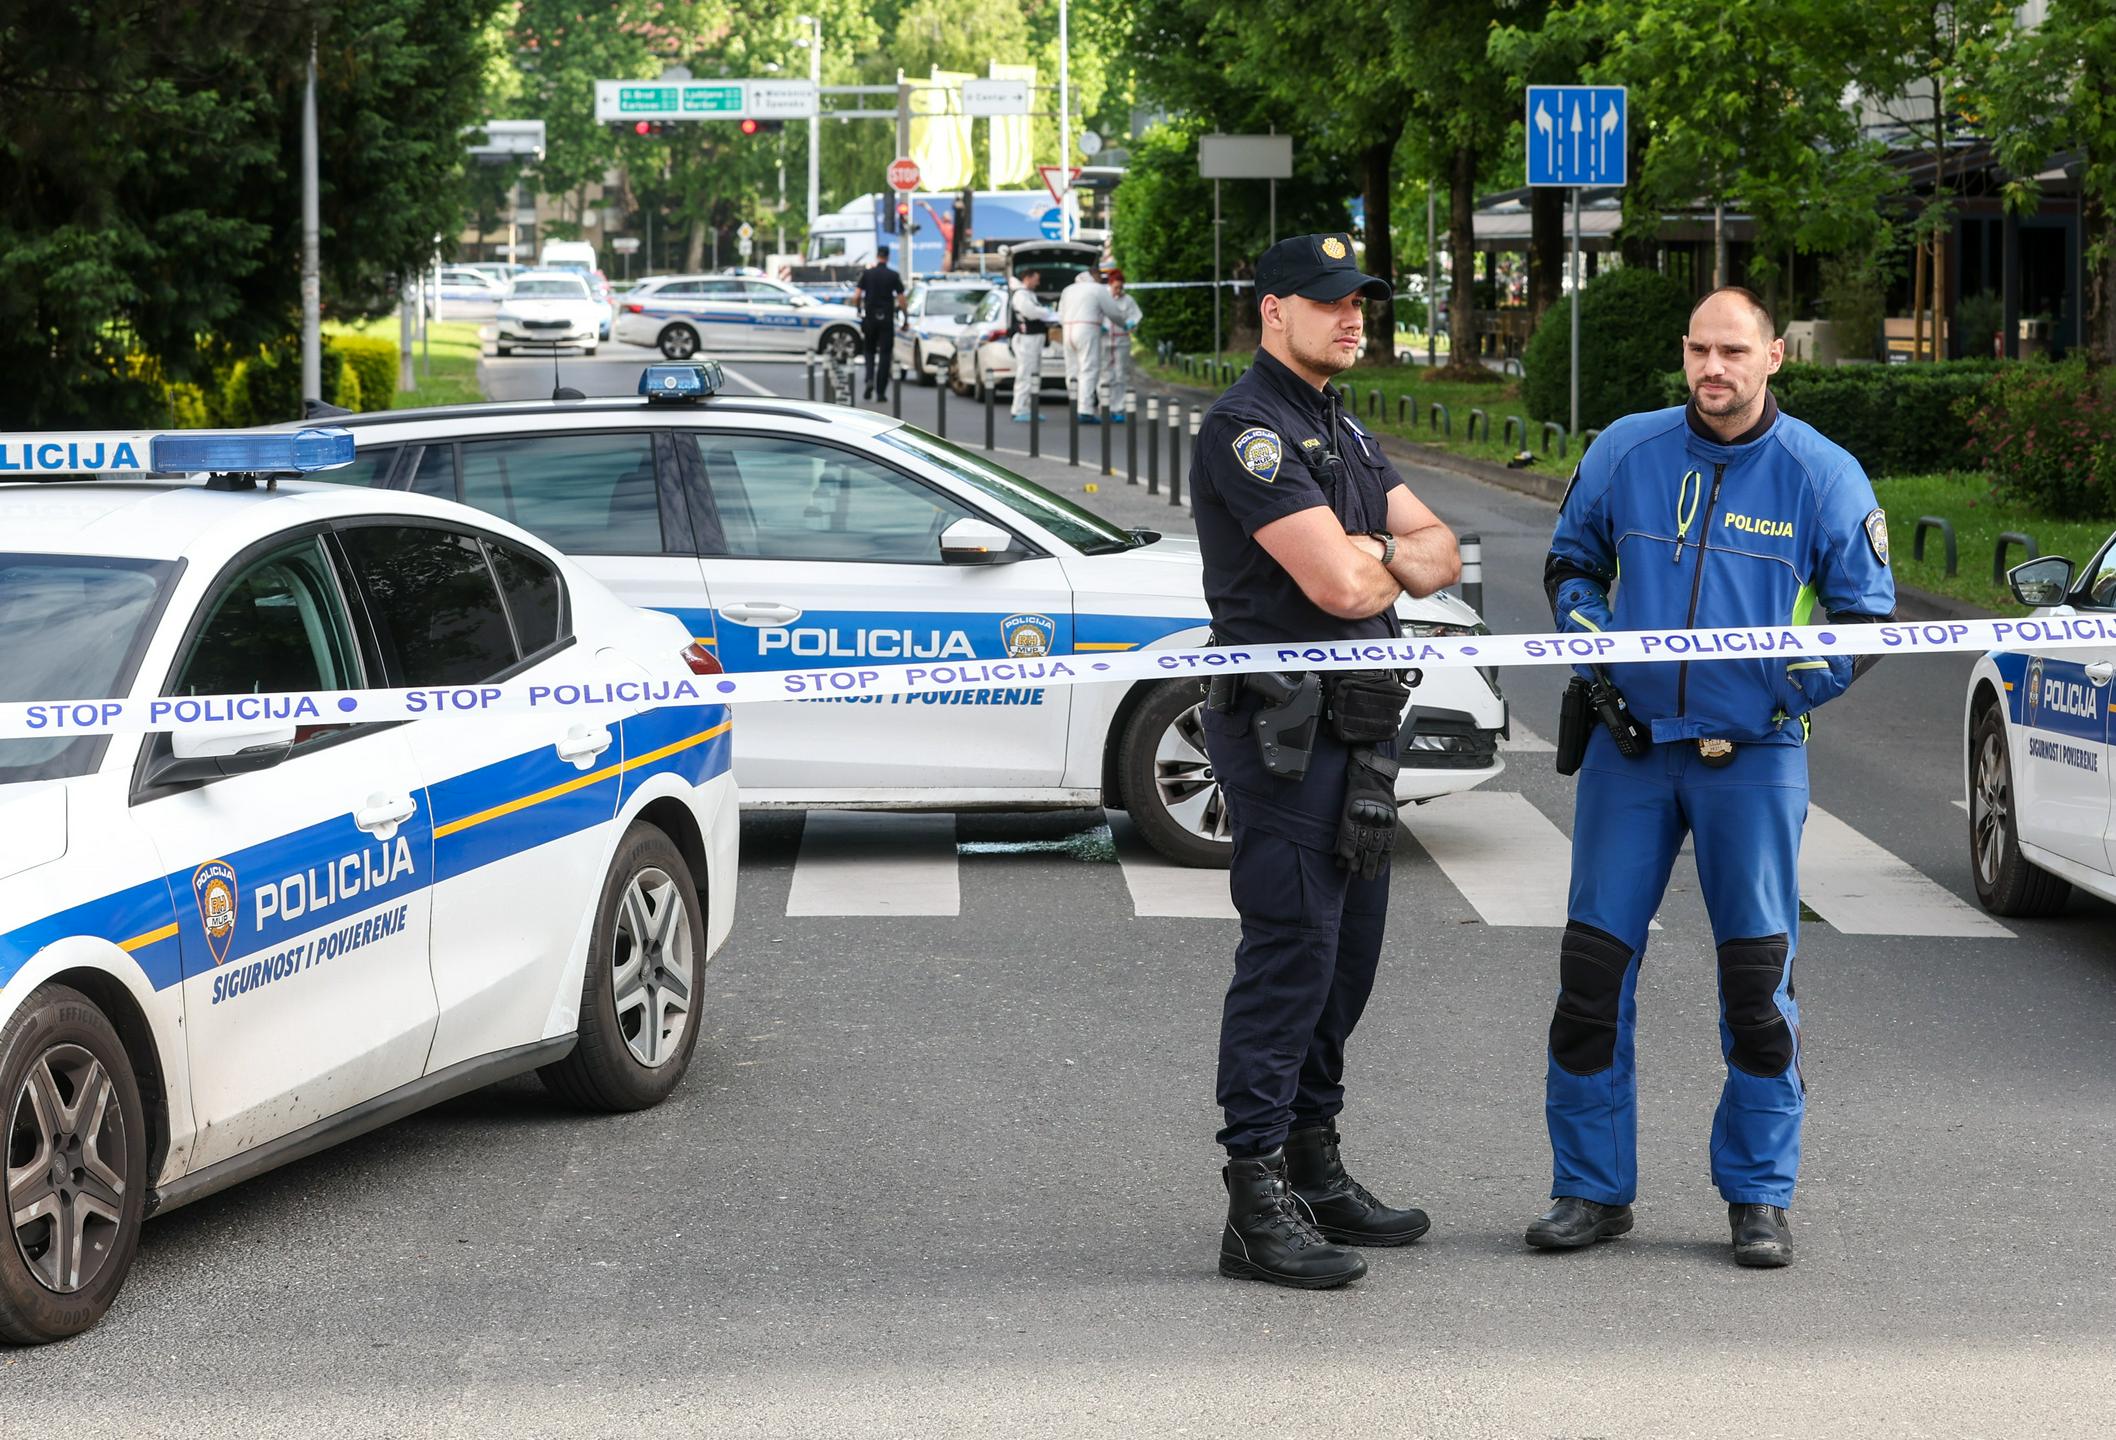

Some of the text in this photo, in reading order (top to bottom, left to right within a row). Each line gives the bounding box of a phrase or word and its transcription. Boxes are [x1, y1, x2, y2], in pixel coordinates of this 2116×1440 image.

[892, 169, 920, 184] STOP
[1236, 430, 1276, 449] POLICIJA
[1724, 512, 1793, 538] POLICIJA
[1004, 616, 1052, 630] POLICIJA
[1880, 624, 1969, 646] STOP
[757, 628, 977, 659] POLICIJA
[1523, 631, 1804, 657] STOP POLICIJA
[784, 662, 1075, 693] STOP POLICIJA
[405, 680, 699, 713] STOP POLICIJA
[905, 688, 1045, 705] POVJERENJE
[2043, 678, 2097, 720] POLICIJA
[26, 696, 320, 729] STOP POLICIJA
[2029, 737, 2059, 762] SIGURNOST
[2063, 746, 2098, 772] POVJERENJE
[195, 866, 234, 890] POLICIJA
[254, 835, 415, 932] POLICIJA
[211, 914, 229, 926] MUP
[212, 903, 408, 1004] SIGURNOST I POVJERENJE
